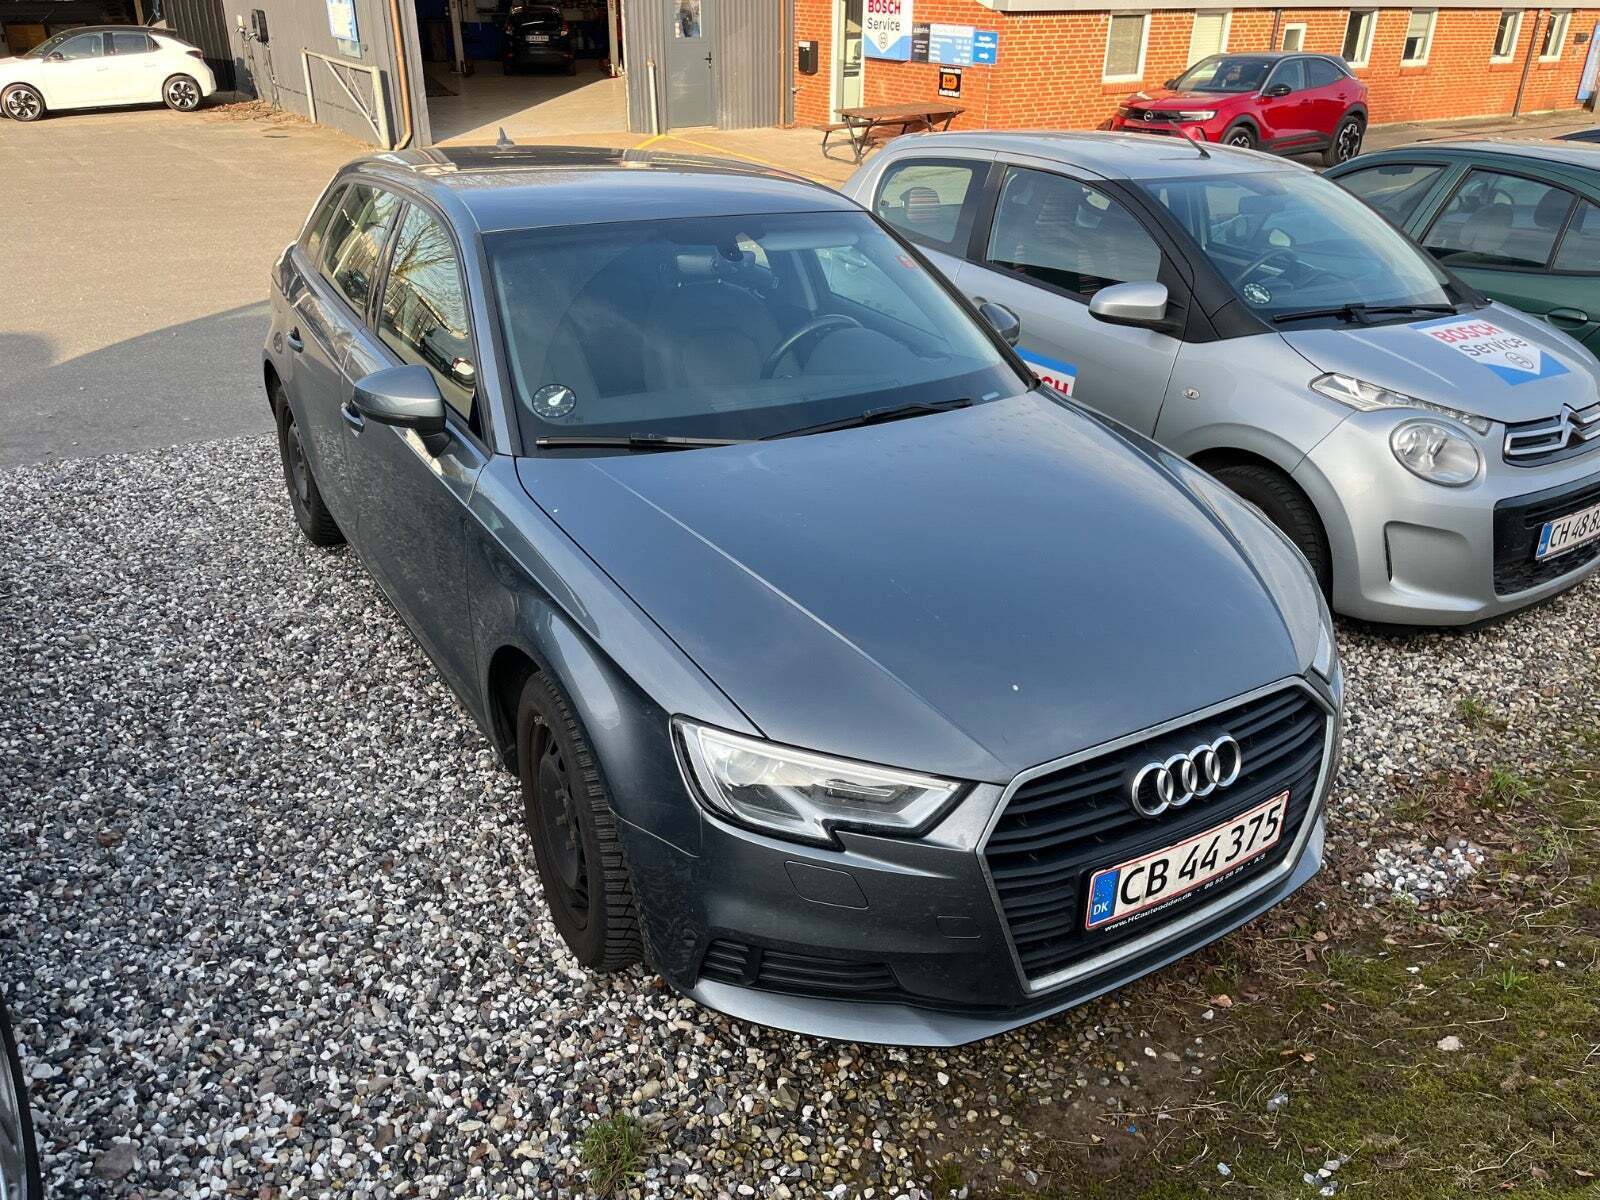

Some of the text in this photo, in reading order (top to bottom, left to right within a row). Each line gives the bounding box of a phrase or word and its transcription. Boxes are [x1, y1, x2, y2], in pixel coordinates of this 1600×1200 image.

[867, 0, 901, 14] BOSCH
[867, 17, 901, 31] Service
[1431, 321, 1503, 344] BOSCH
[1459, 337, 1528, 357] Service
[1550, 520, 1571, 547] CH
[1572, 514, 1589, 539] 48
[1120, 803, 1282, 905] CB 44 375
[1093, 900, 1109, 916] DK
